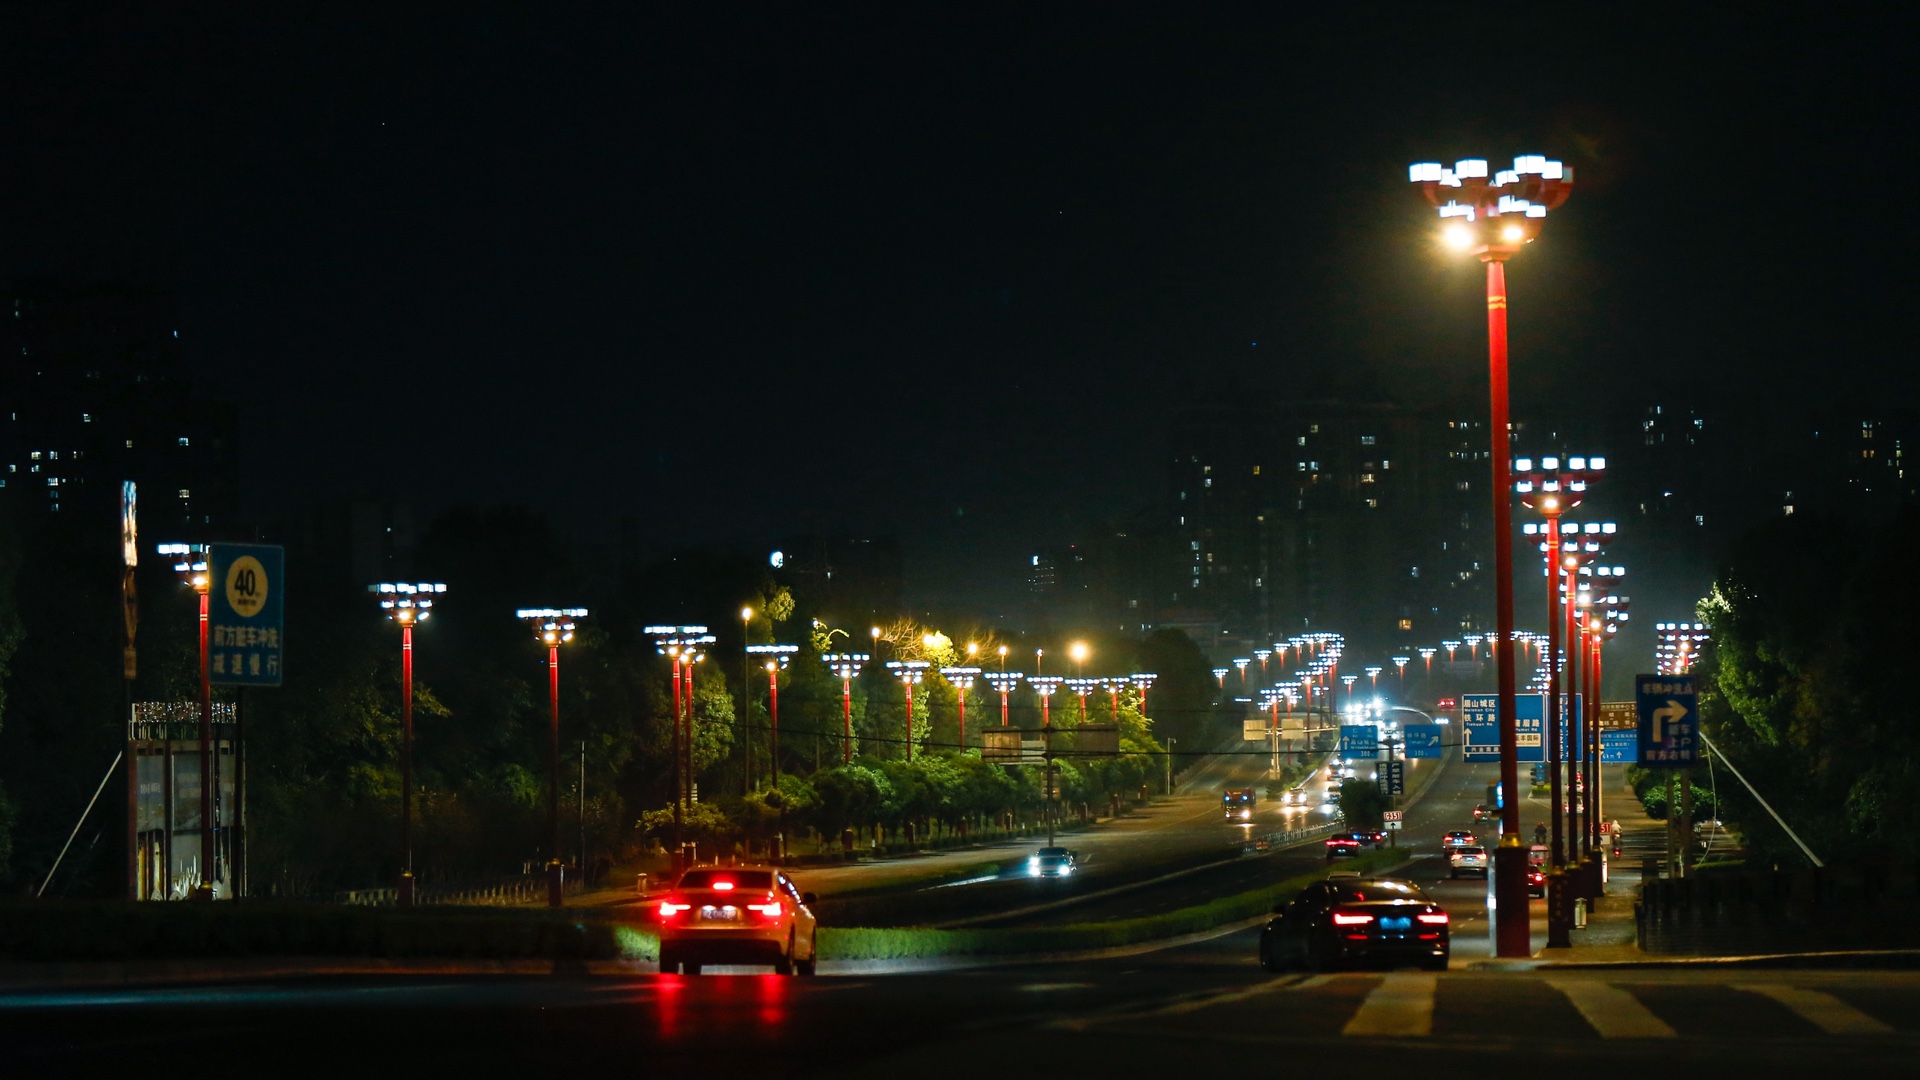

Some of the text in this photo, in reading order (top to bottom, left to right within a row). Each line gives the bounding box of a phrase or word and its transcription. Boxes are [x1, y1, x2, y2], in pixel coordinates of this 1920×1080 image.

[234, 568, 256, 596] 40
[1464, 699, 1496, 708] 眉山城区
[1464, 714, 1496, 722] 铁环路
[1386, 812, 1400, 820] G351
